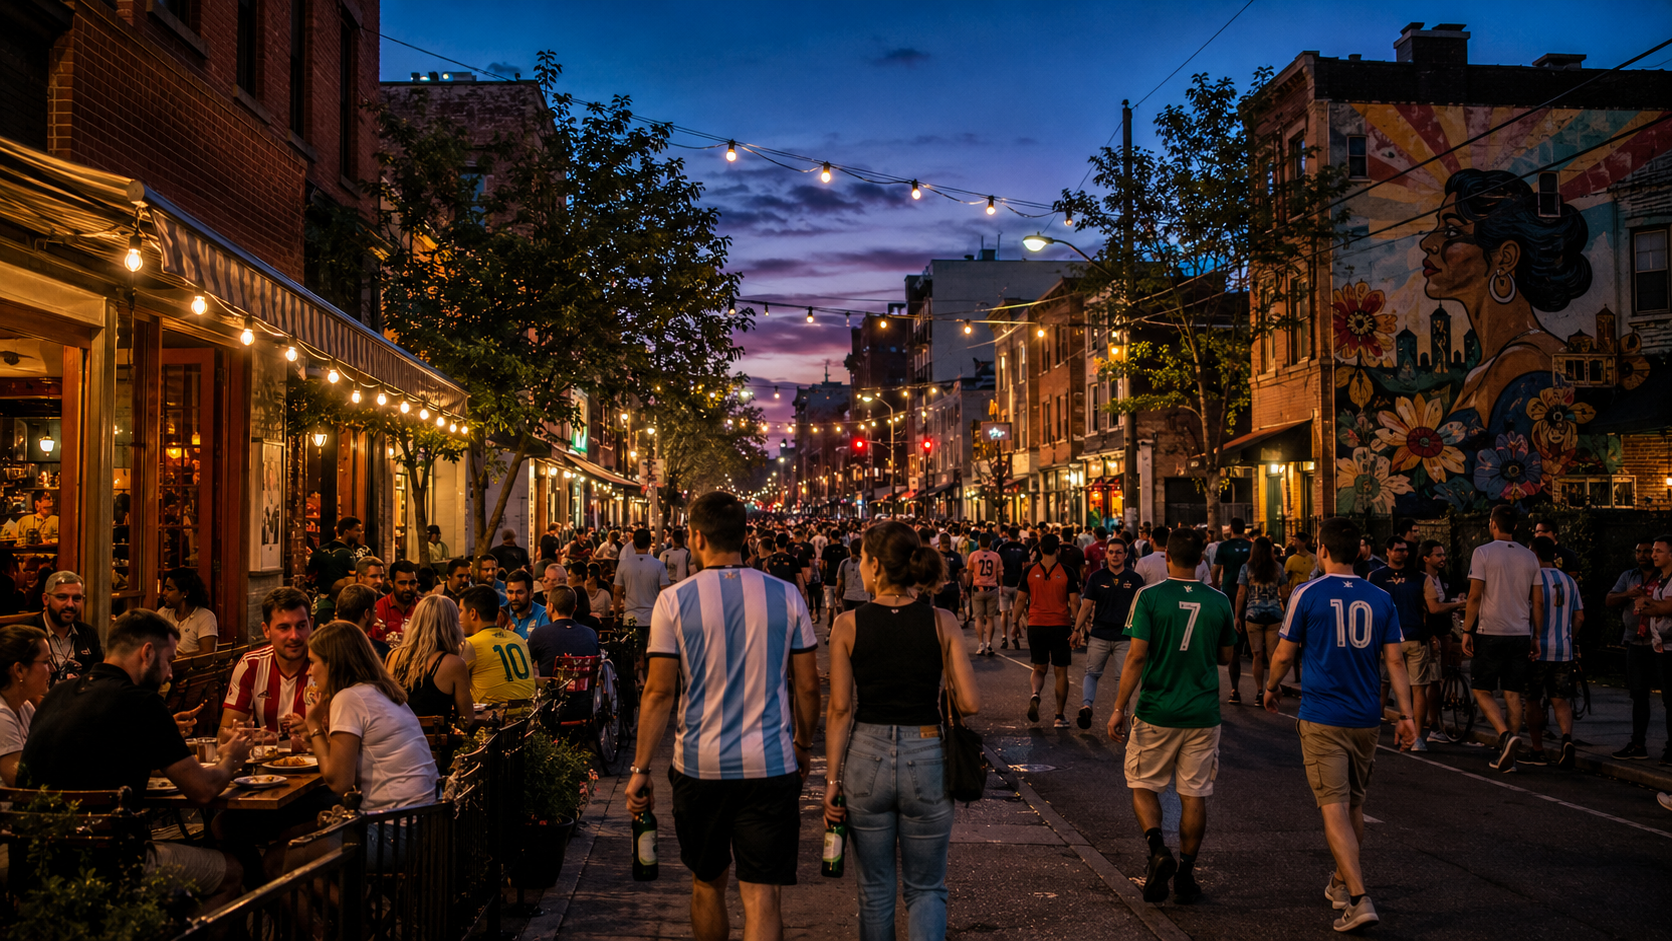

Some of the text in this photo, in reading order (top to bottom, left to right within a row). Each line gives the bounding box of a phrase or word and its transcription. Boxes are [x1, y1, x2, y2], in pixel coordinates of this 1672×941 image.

[978, 559, 993, 577] 29
[1178, 601, 1201, 651] 7
[1330, 598, 1373, 649] 10
[492, 643, 529, 682] 10
